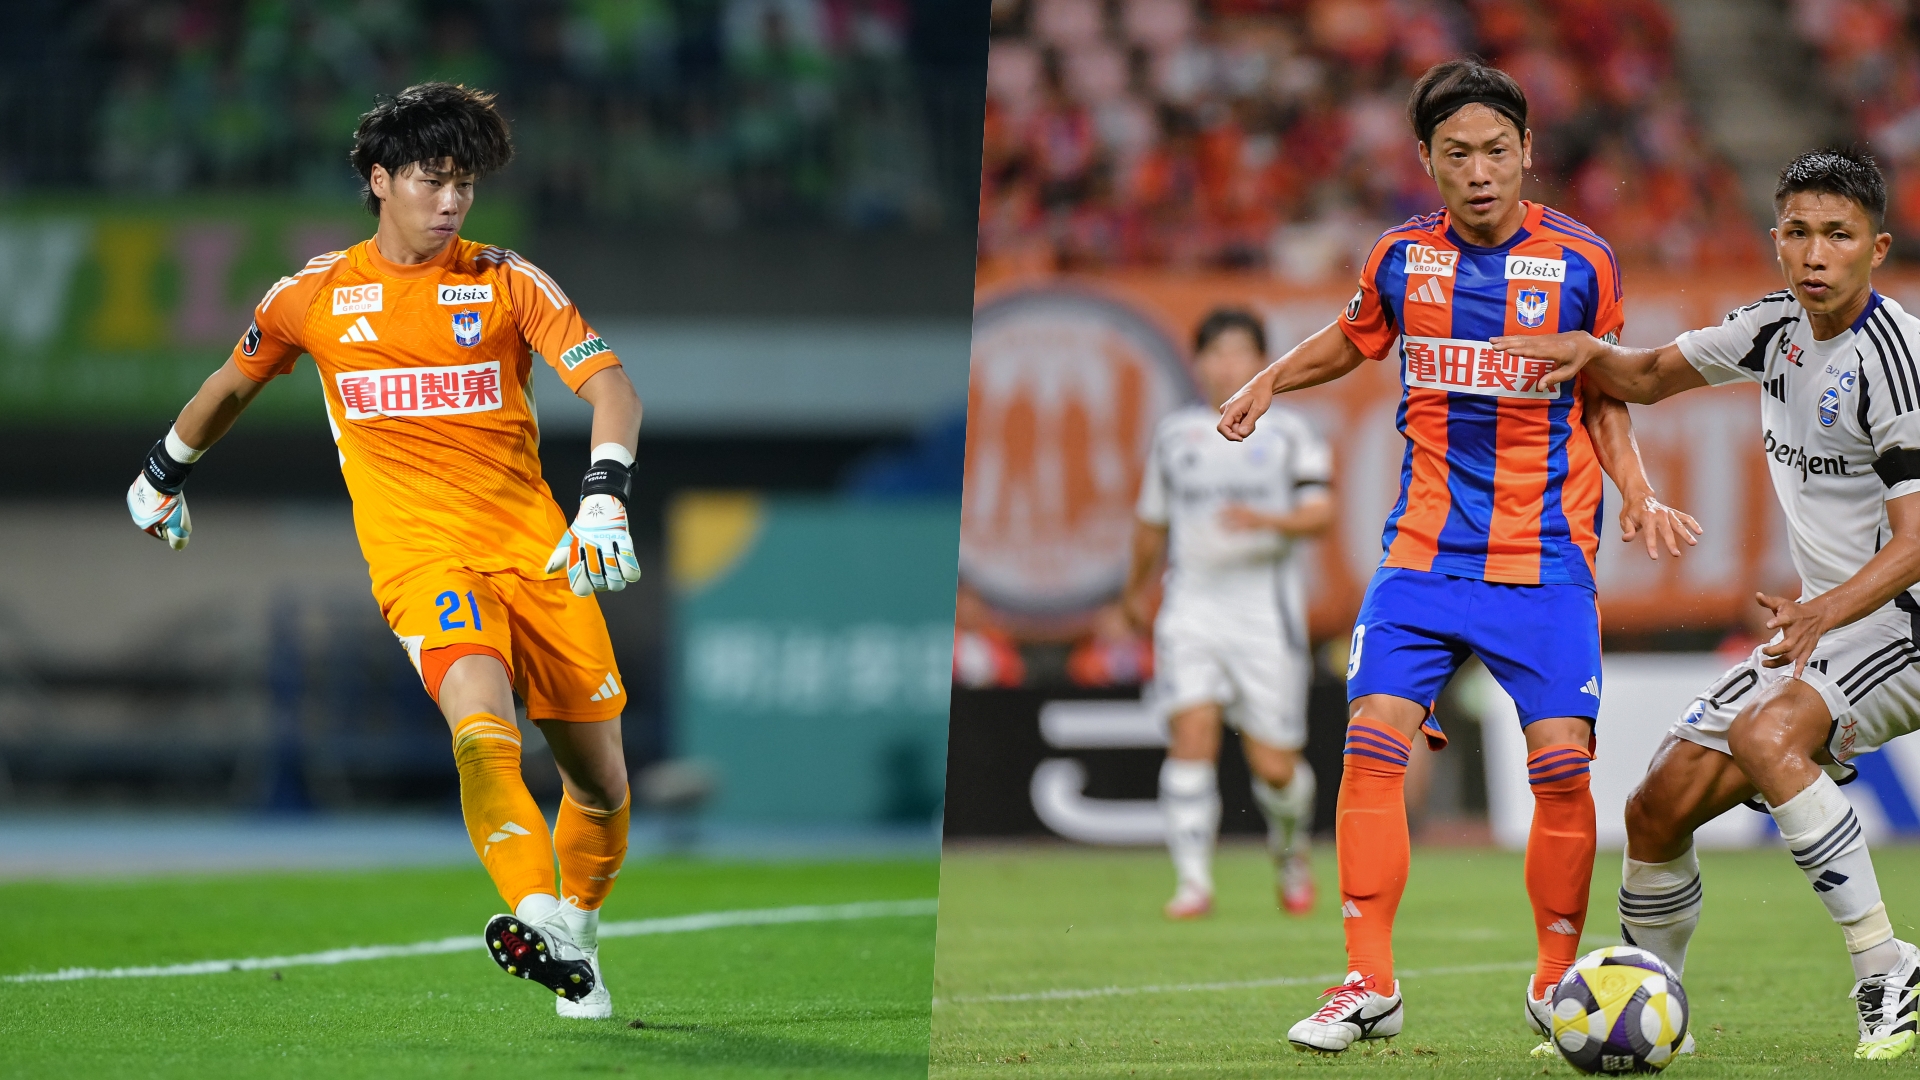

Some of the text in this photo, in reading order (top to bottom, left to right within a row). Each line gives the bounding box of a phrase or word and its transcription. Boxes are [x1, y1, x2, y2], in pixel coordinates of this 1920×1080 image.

[1409, 246, 1453, 266] NSG
[1413, 265, 1443, 273] GROUP
[1510, 260, 1561, 278] Oisix
[336, 285, 379, 306] NSG
[441, 288, 488, 302] Oisix
[342, 303, 372, 312] GROUP
[341, 367, 500, 414] 亀田製菓
[434, 590, 482, 632] 21
